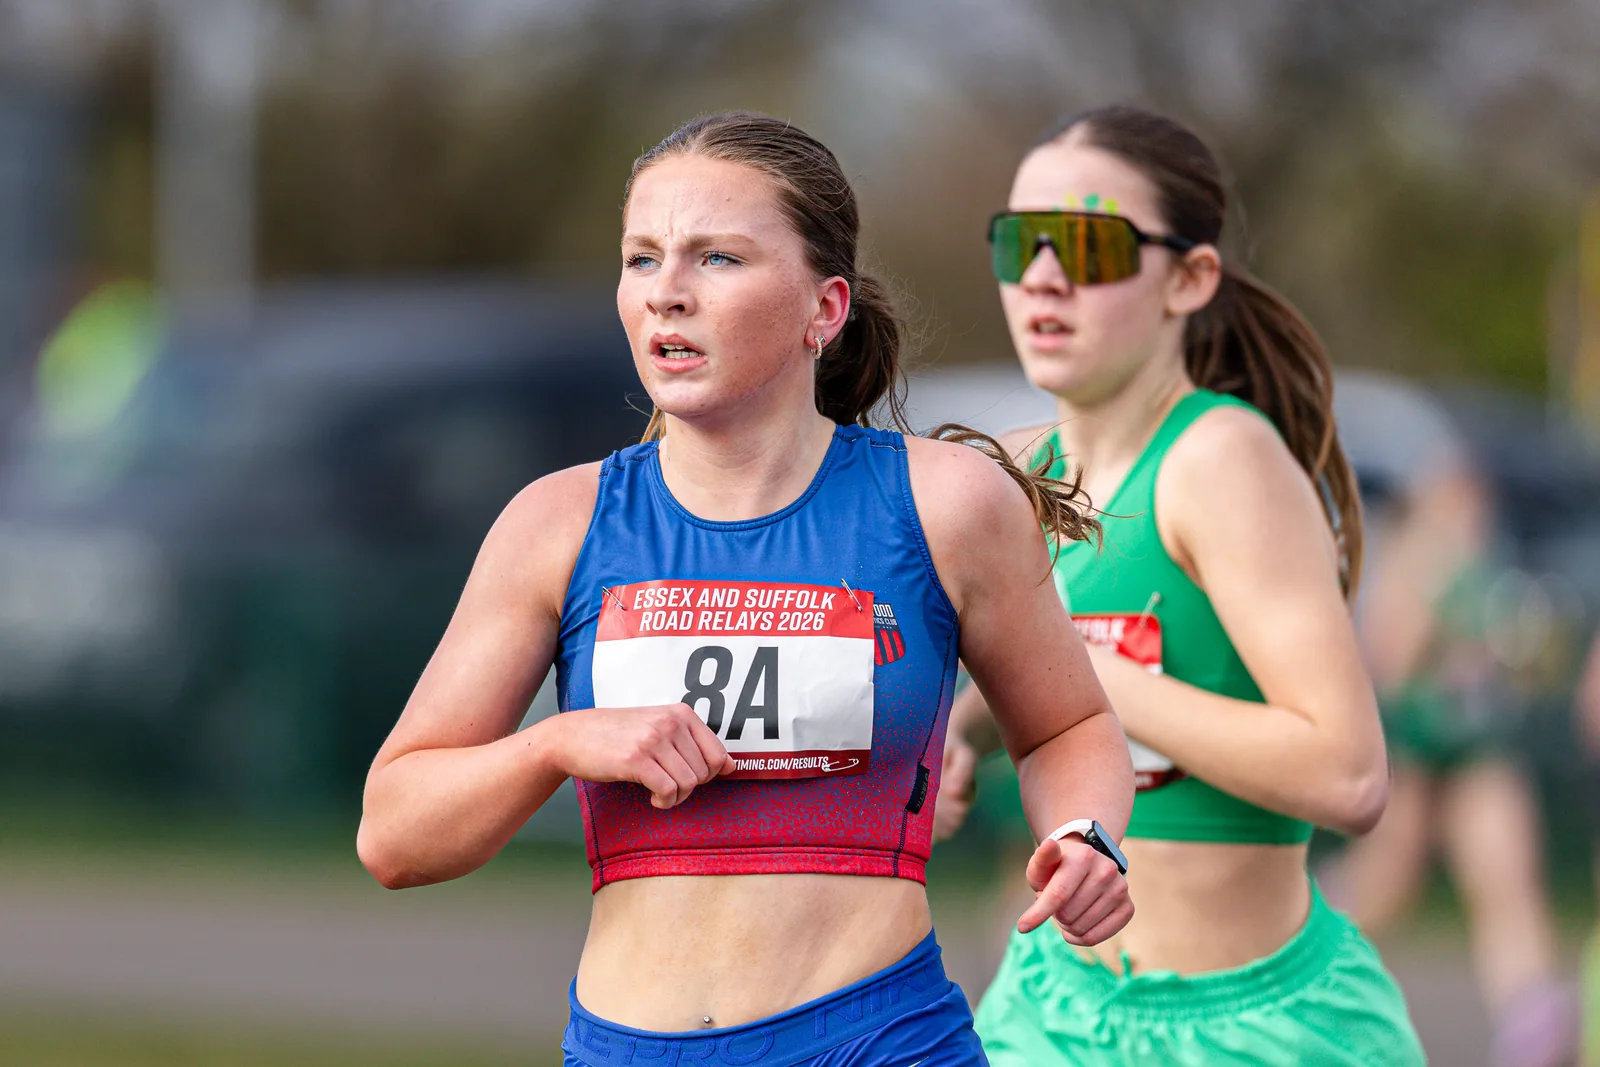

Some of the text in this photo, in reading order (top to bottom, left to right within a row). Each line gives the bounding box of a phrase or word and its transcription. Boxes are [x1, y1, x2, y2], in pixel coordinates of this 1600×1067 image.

[633, 587, 837, 611] ESSEX AND SUFFOLK
[639, 610, 825, 631] ROAD RELAYS 2026
[681, 645, 780, 740] 8A
[733, 756, 829, 771] TIMING.COM/RESULTS
